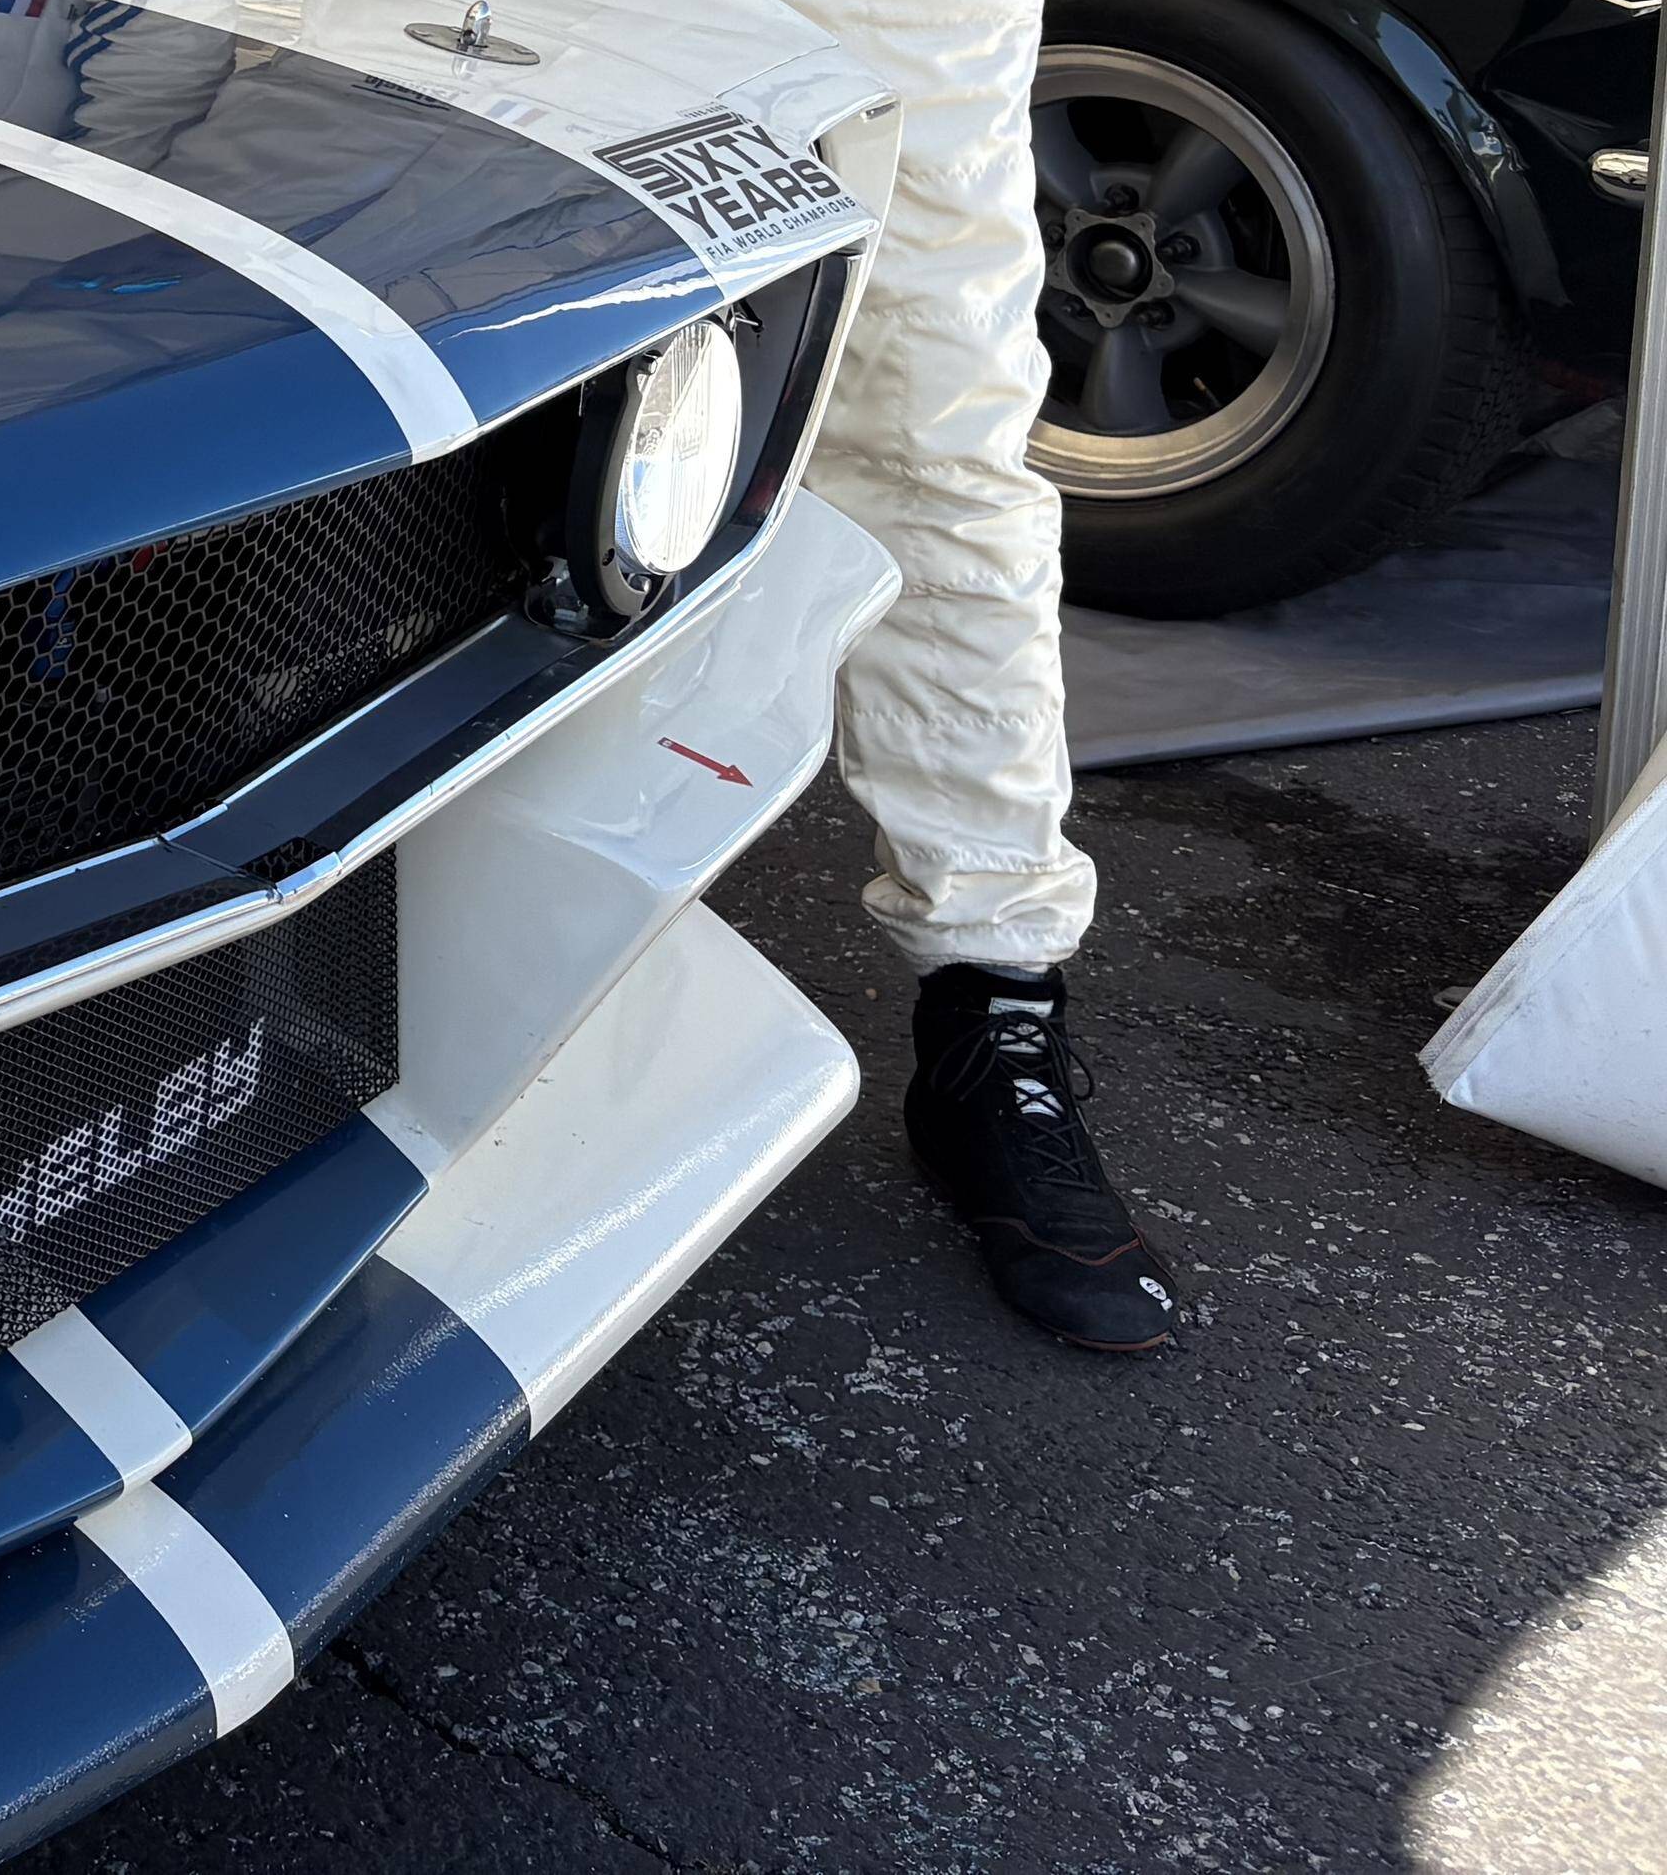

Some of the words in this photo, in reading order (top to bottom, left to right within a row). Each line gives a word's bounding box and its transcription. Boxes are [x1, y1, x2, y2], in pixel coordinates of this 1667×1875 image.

[667, 158, 841, 240] YEARS
[736, 222, 781, 249] WORLD
[783, 196, 857, 232] CHAMPIONS
